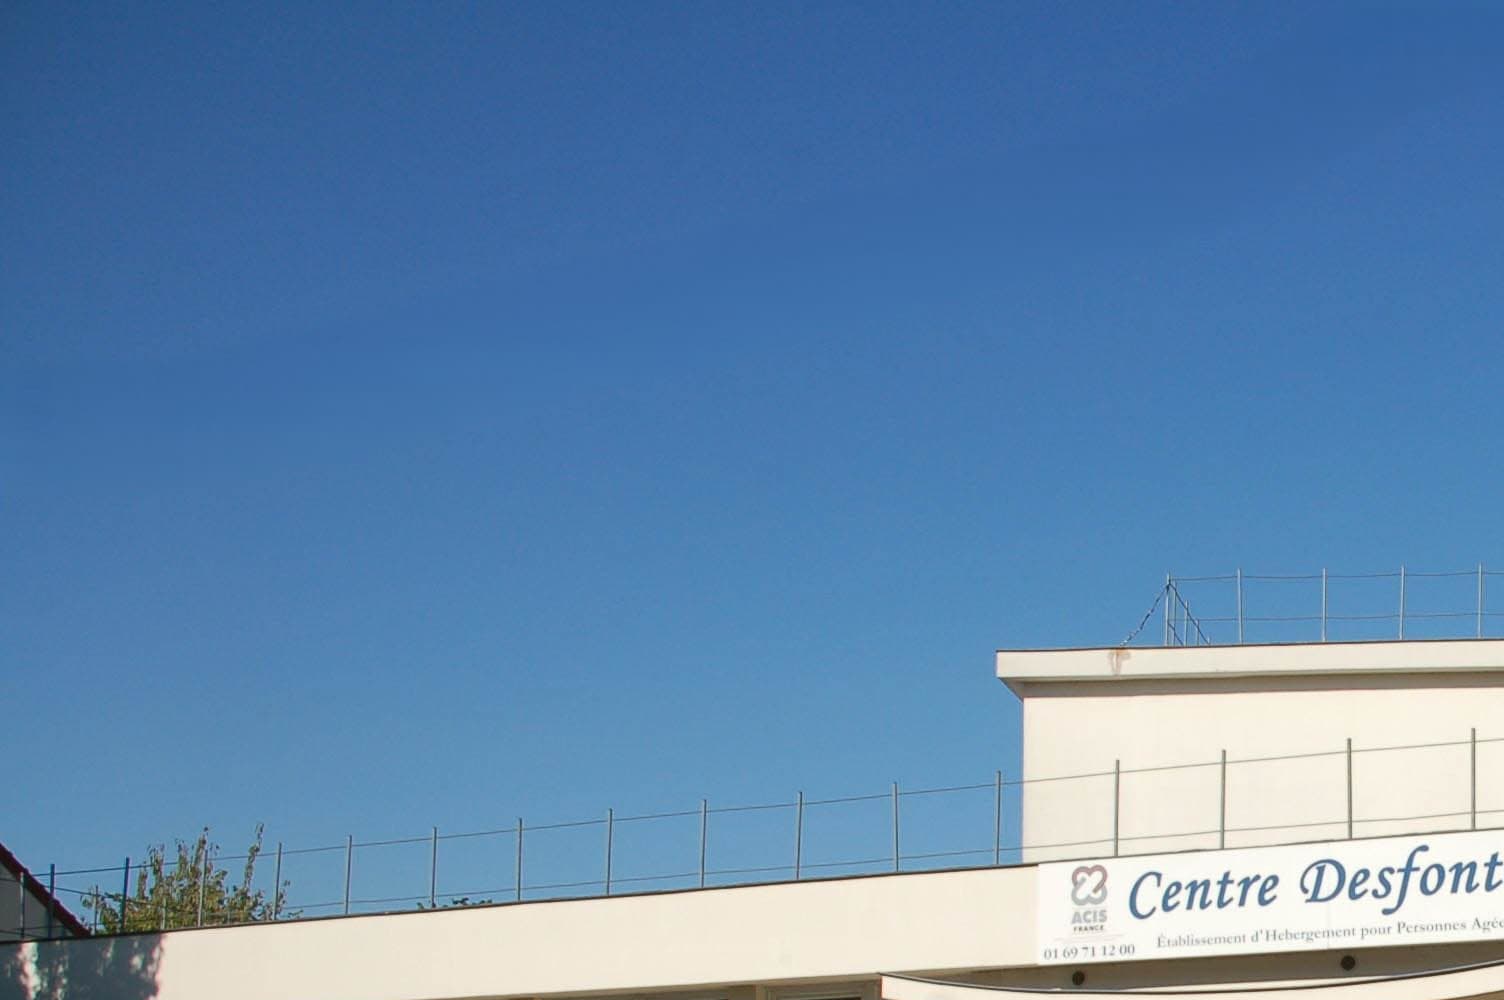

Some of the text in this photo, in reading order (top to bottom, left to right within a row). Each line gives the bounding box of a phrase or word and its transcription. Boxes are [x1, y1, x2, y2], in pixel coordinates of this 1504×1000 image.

[1128, 869, 1280, 920] Centre
[1071, 909, 1108, 924] ACIS
[1073, 924, 1104, 932] FRANCE
[1157, 933, 1246, 949] Établissement
[1360, 925, 1392, 940] pour
[1397, 919, 1466, 934] Personnes
[1043, 943, 1135, 960] 01 69 71 12 00
